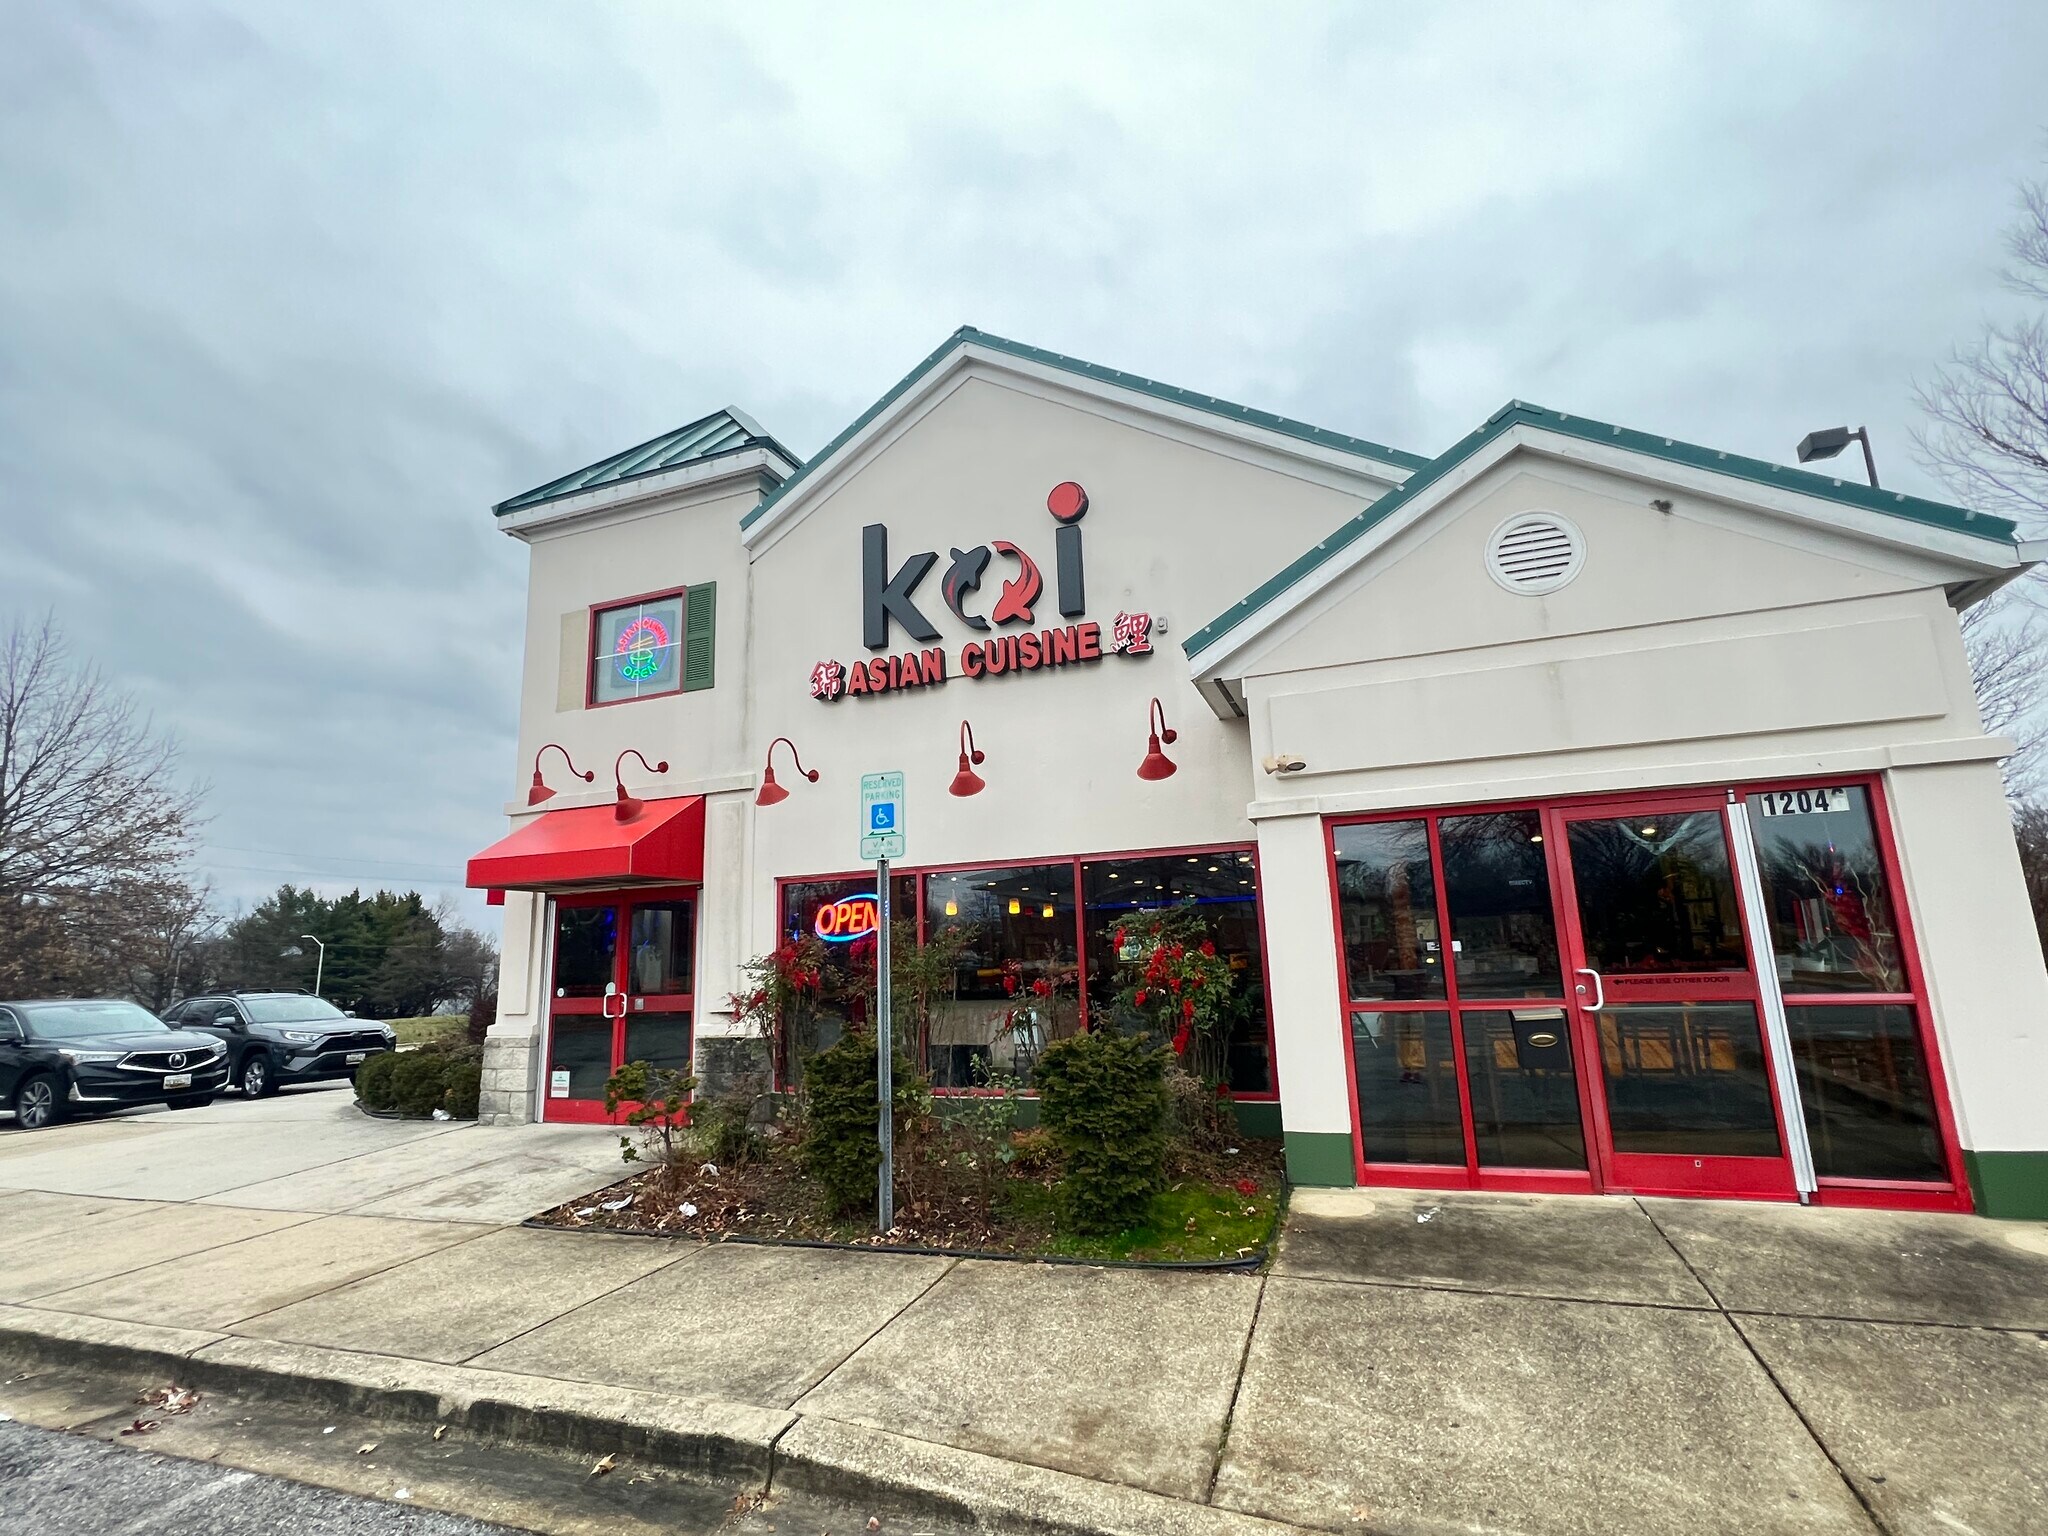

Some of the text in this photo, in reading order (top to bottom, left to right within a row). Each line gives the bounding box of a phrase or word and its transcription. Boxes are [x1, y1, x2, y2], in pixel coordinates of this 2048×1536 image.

[616, 620, 641, 653] ASIAN
[1109, 610, 1154, 655] 鯉
[847, 622, 1102, 696] ASIAN CUISINE
[623, 661, 658, 679] OPEN
[808, 659, 846, 700] 錦
[863, 777, 902, 790] RESERVED
[865, 789, 900, 801] PARKING
[867, 847, 898, 856] ACCEIBLE
[872, 840, 893, 848] VAN
[816, 902, 880, 934] OPEN
[1655, 977, 1671, 985] USE
[1673, 976, 1702, 984] OTHER
[1704, 974, 1730, 983] DOOR
